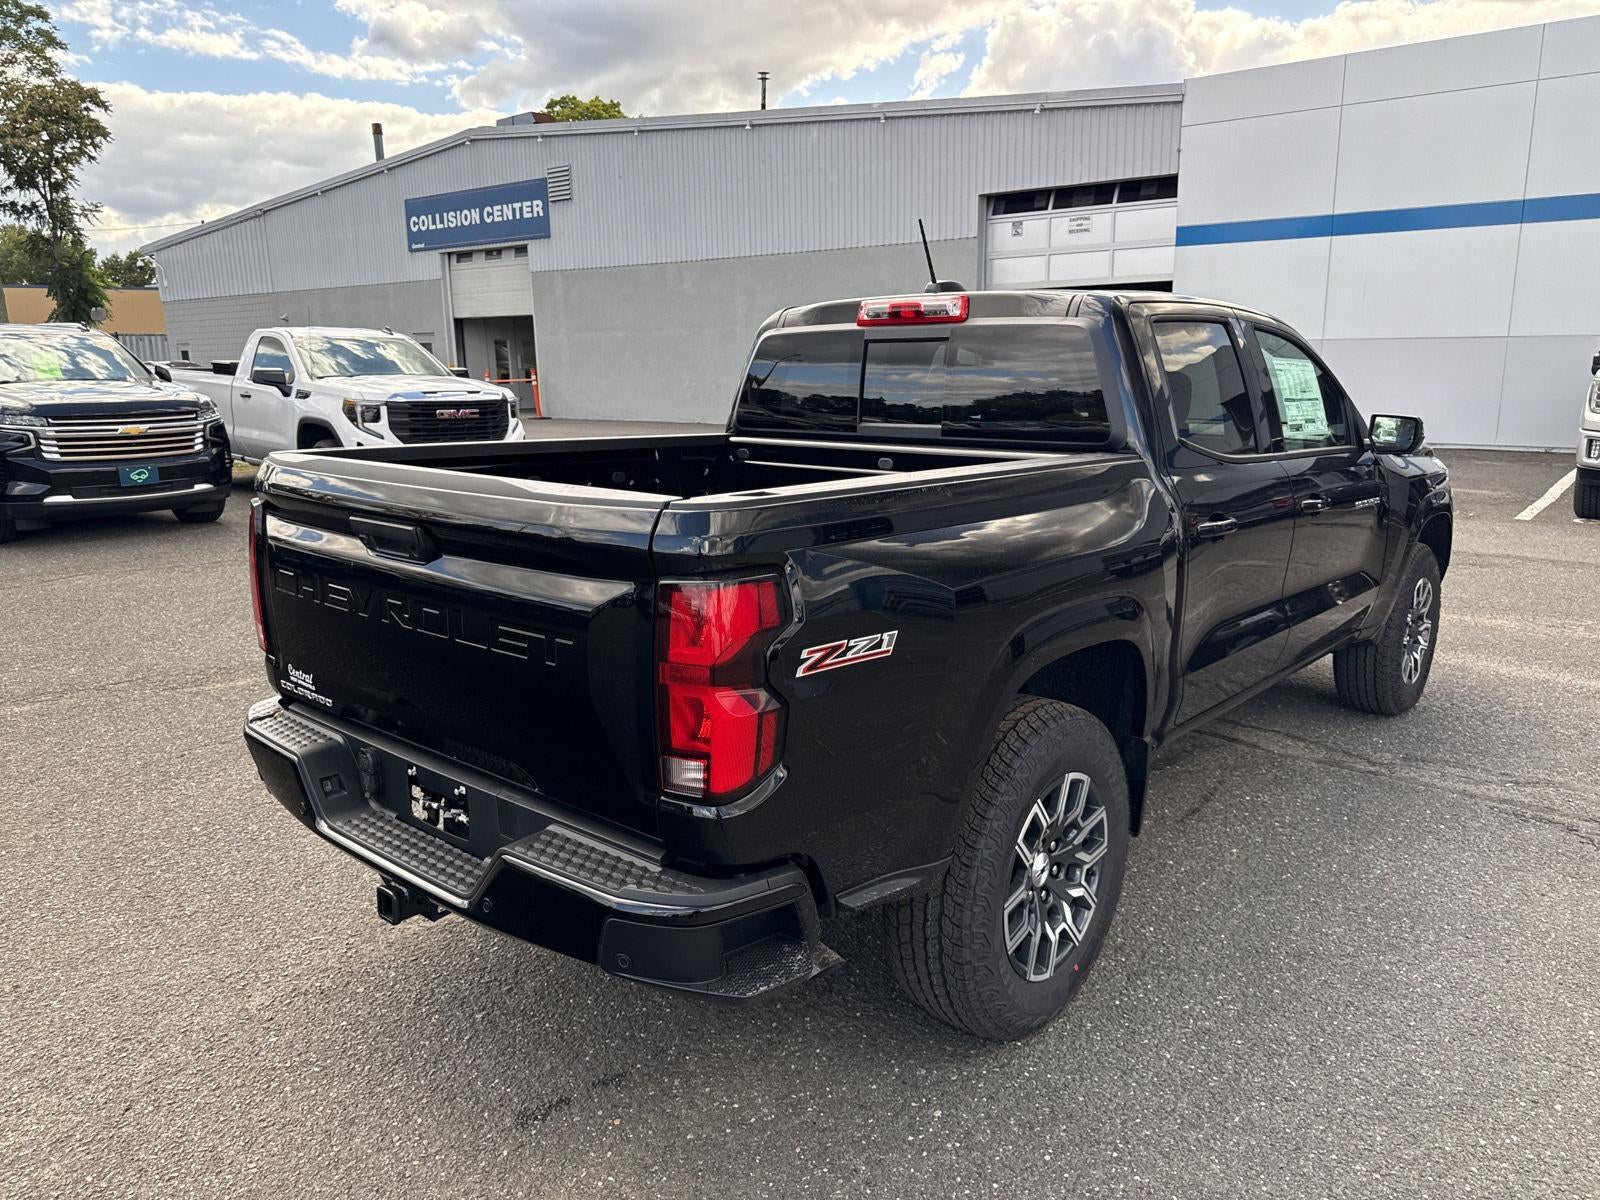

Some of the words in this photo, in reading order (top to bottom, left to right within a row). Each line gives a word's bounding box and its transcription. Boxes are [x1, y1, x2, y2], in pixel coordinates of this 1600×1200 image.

[410, 208, 480, 232] COLLISION
[483, 200, 544, 223] CENTER
[436, 409, 480, 419] GMC
[275, 564, 574, 666] CHEVROLET
[795, 630, 898, 678] Z71
[287, 663, 313, 684] Central
[280, 679, 333, 707] COLORADO
